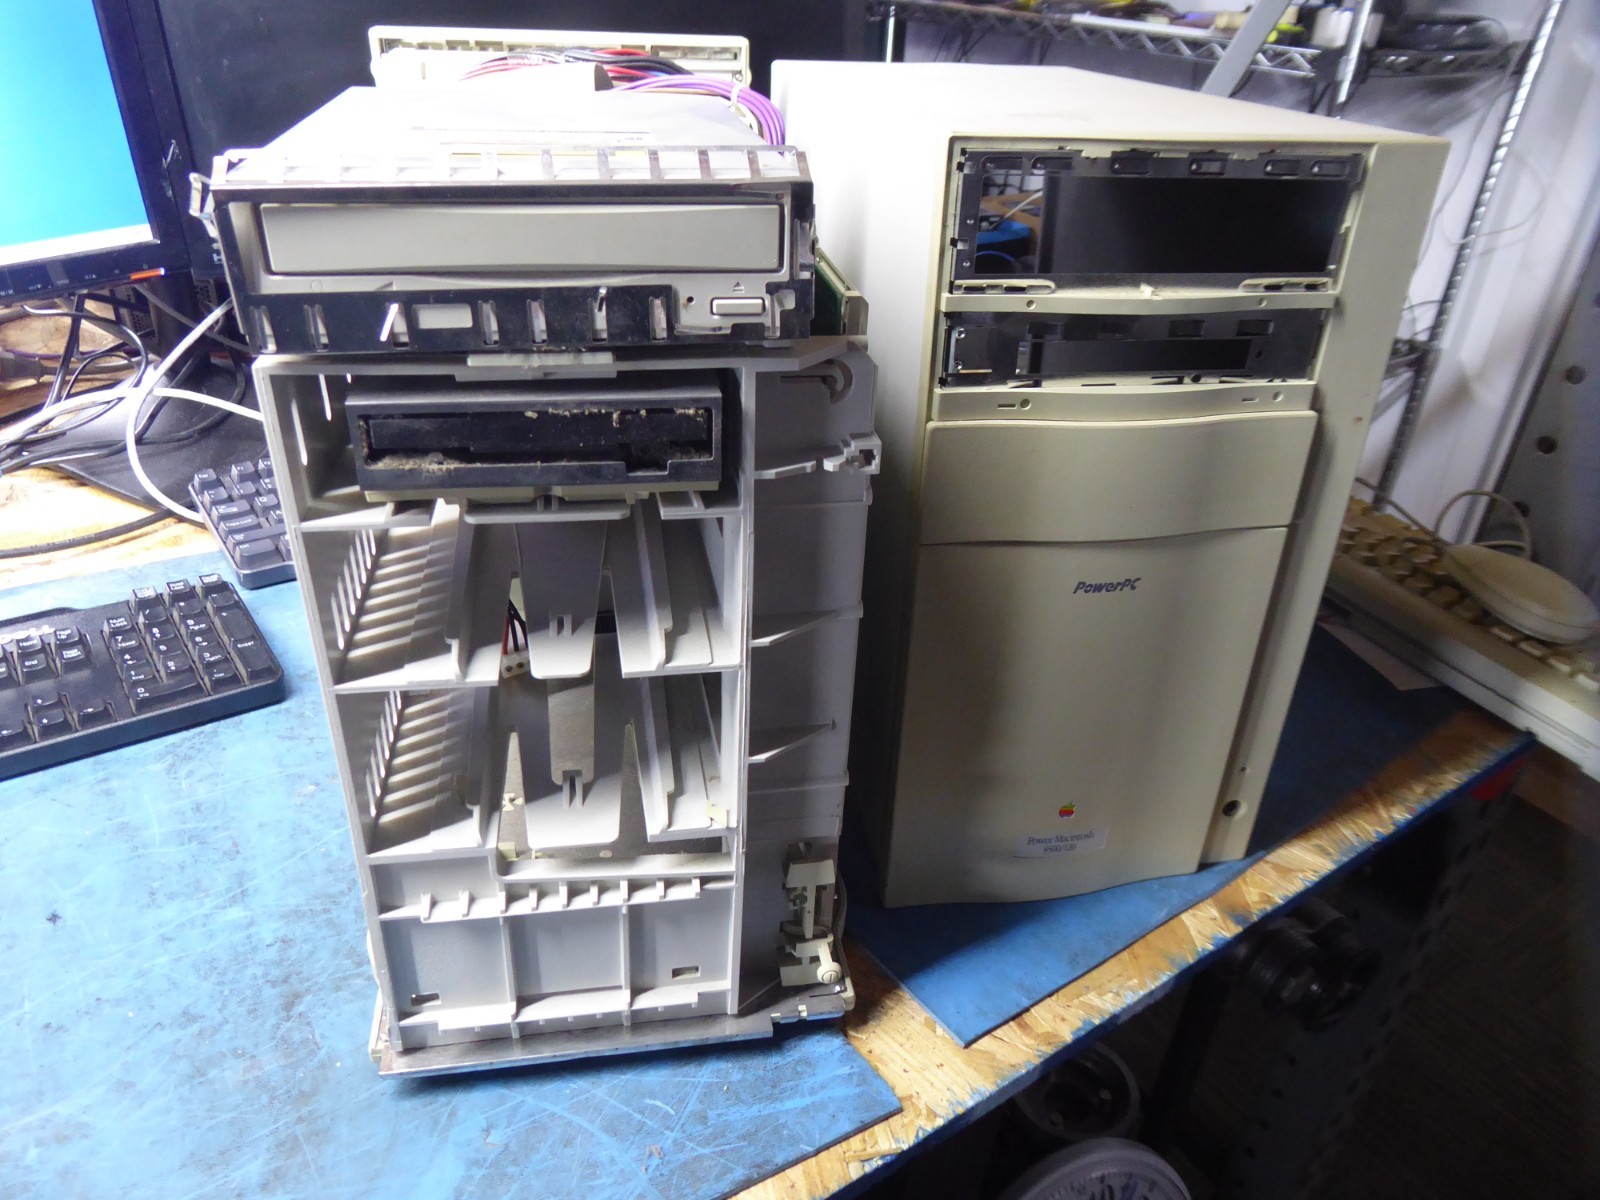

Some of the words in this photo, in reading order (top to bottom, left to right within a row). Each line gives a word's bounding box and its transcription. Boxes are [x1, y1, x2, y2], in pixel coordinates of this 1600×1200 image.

[1073, 577, 1142, 594] PowerPC
[1027, 836, 1054, 846] Power
[1054, 830, 1095, 843] Macintosh
